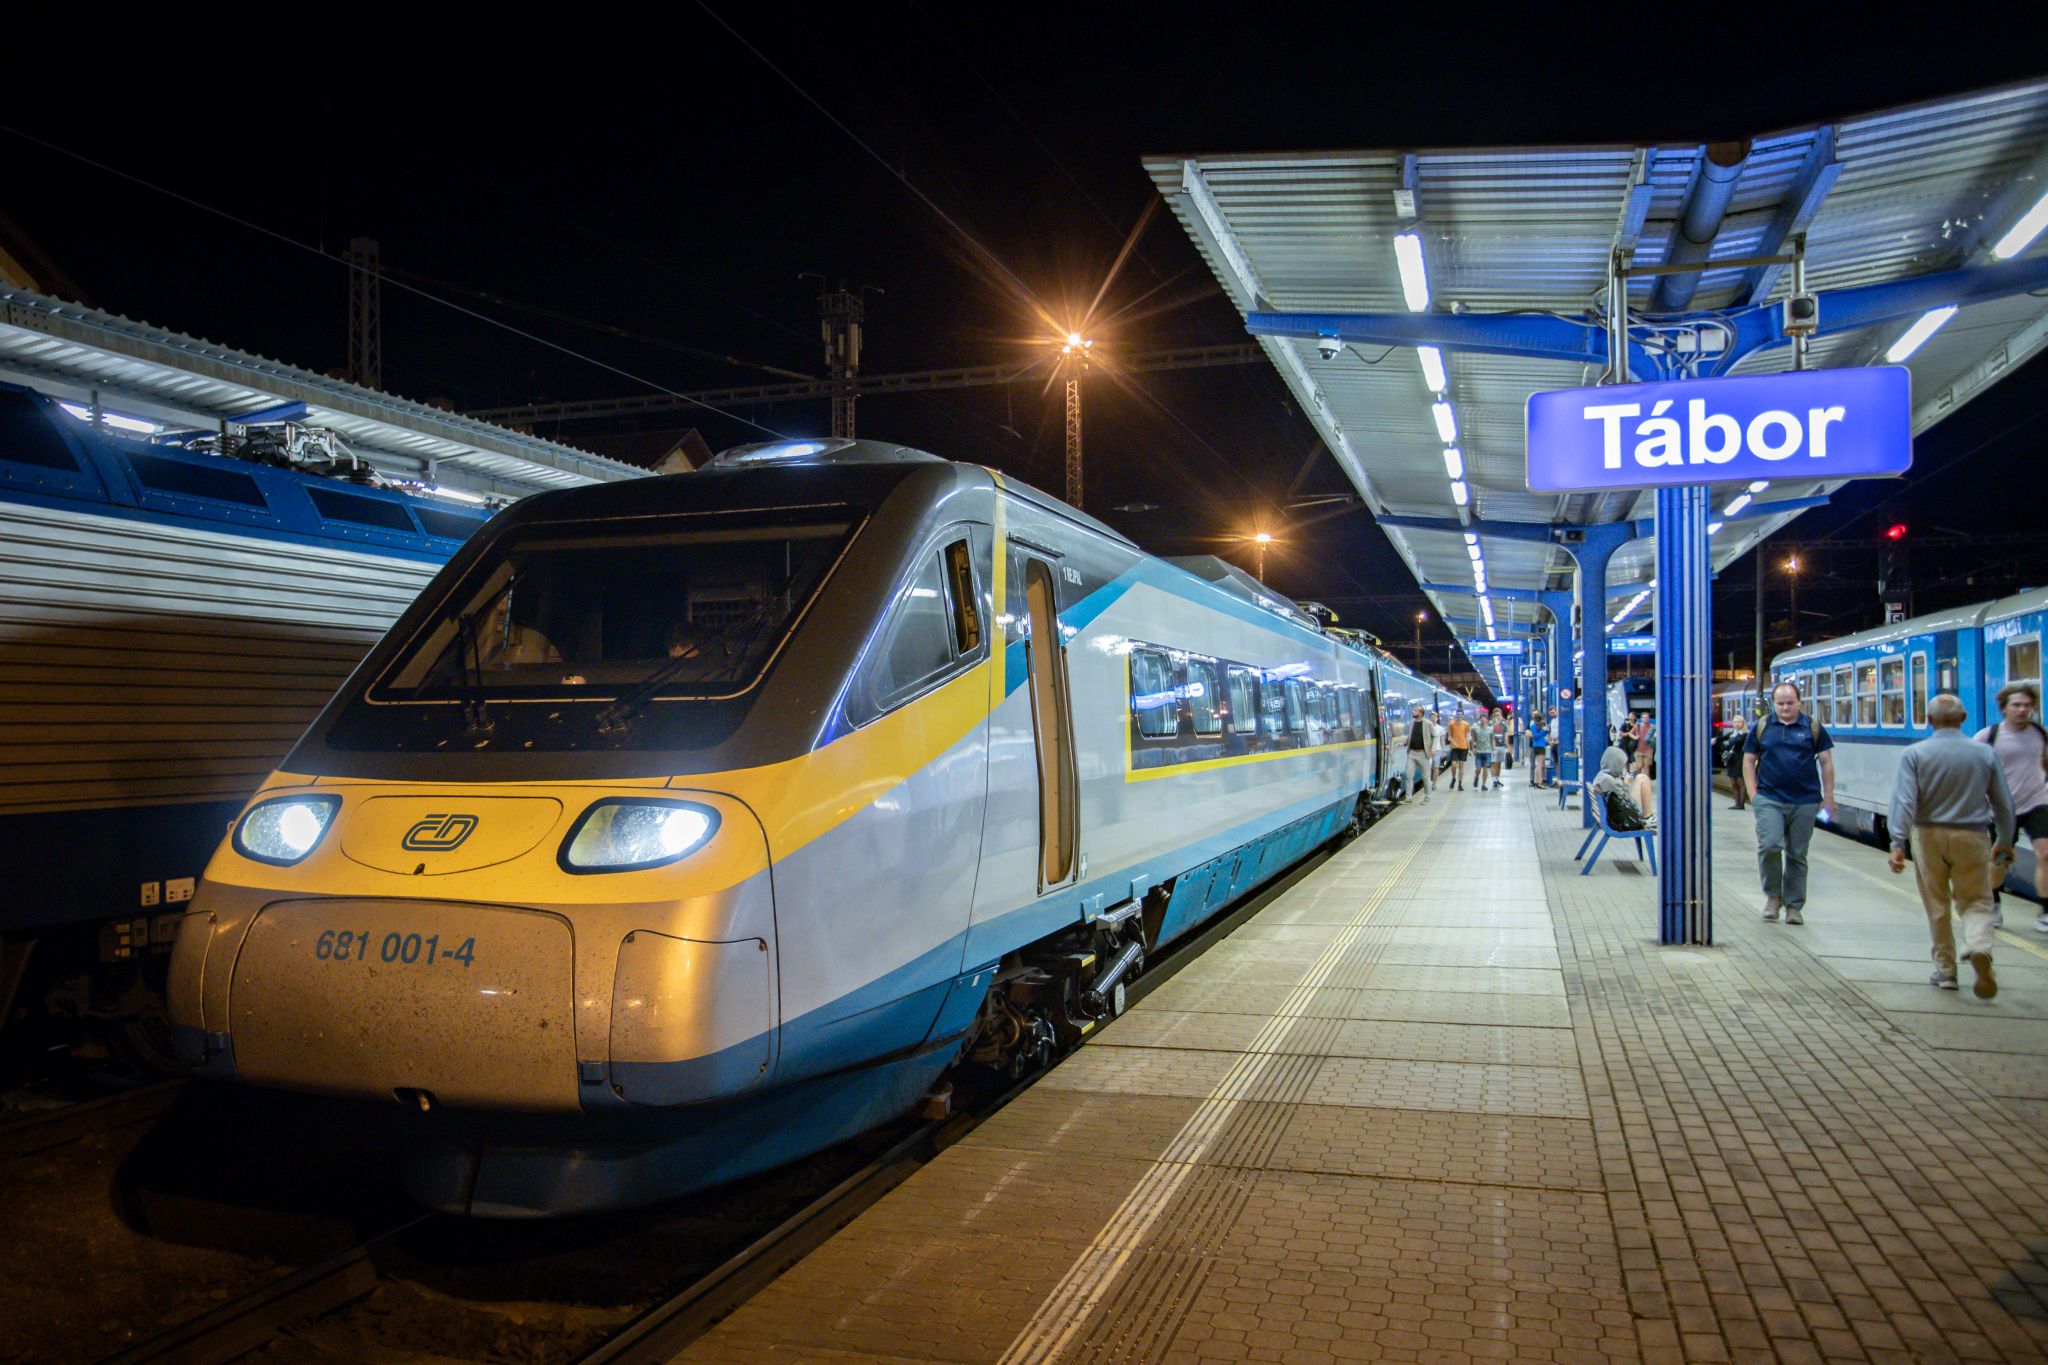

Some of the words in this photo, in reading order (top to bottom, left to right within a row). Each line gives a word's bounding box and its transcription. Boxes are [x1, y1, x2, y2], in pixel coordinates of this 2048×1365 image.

[1583, 398, 1846, 469] Tábor
[1523, 668, 1536, 676] 4F
[316, 930, 369, 961] 681
[381, 932, 476, 968] 001-4
